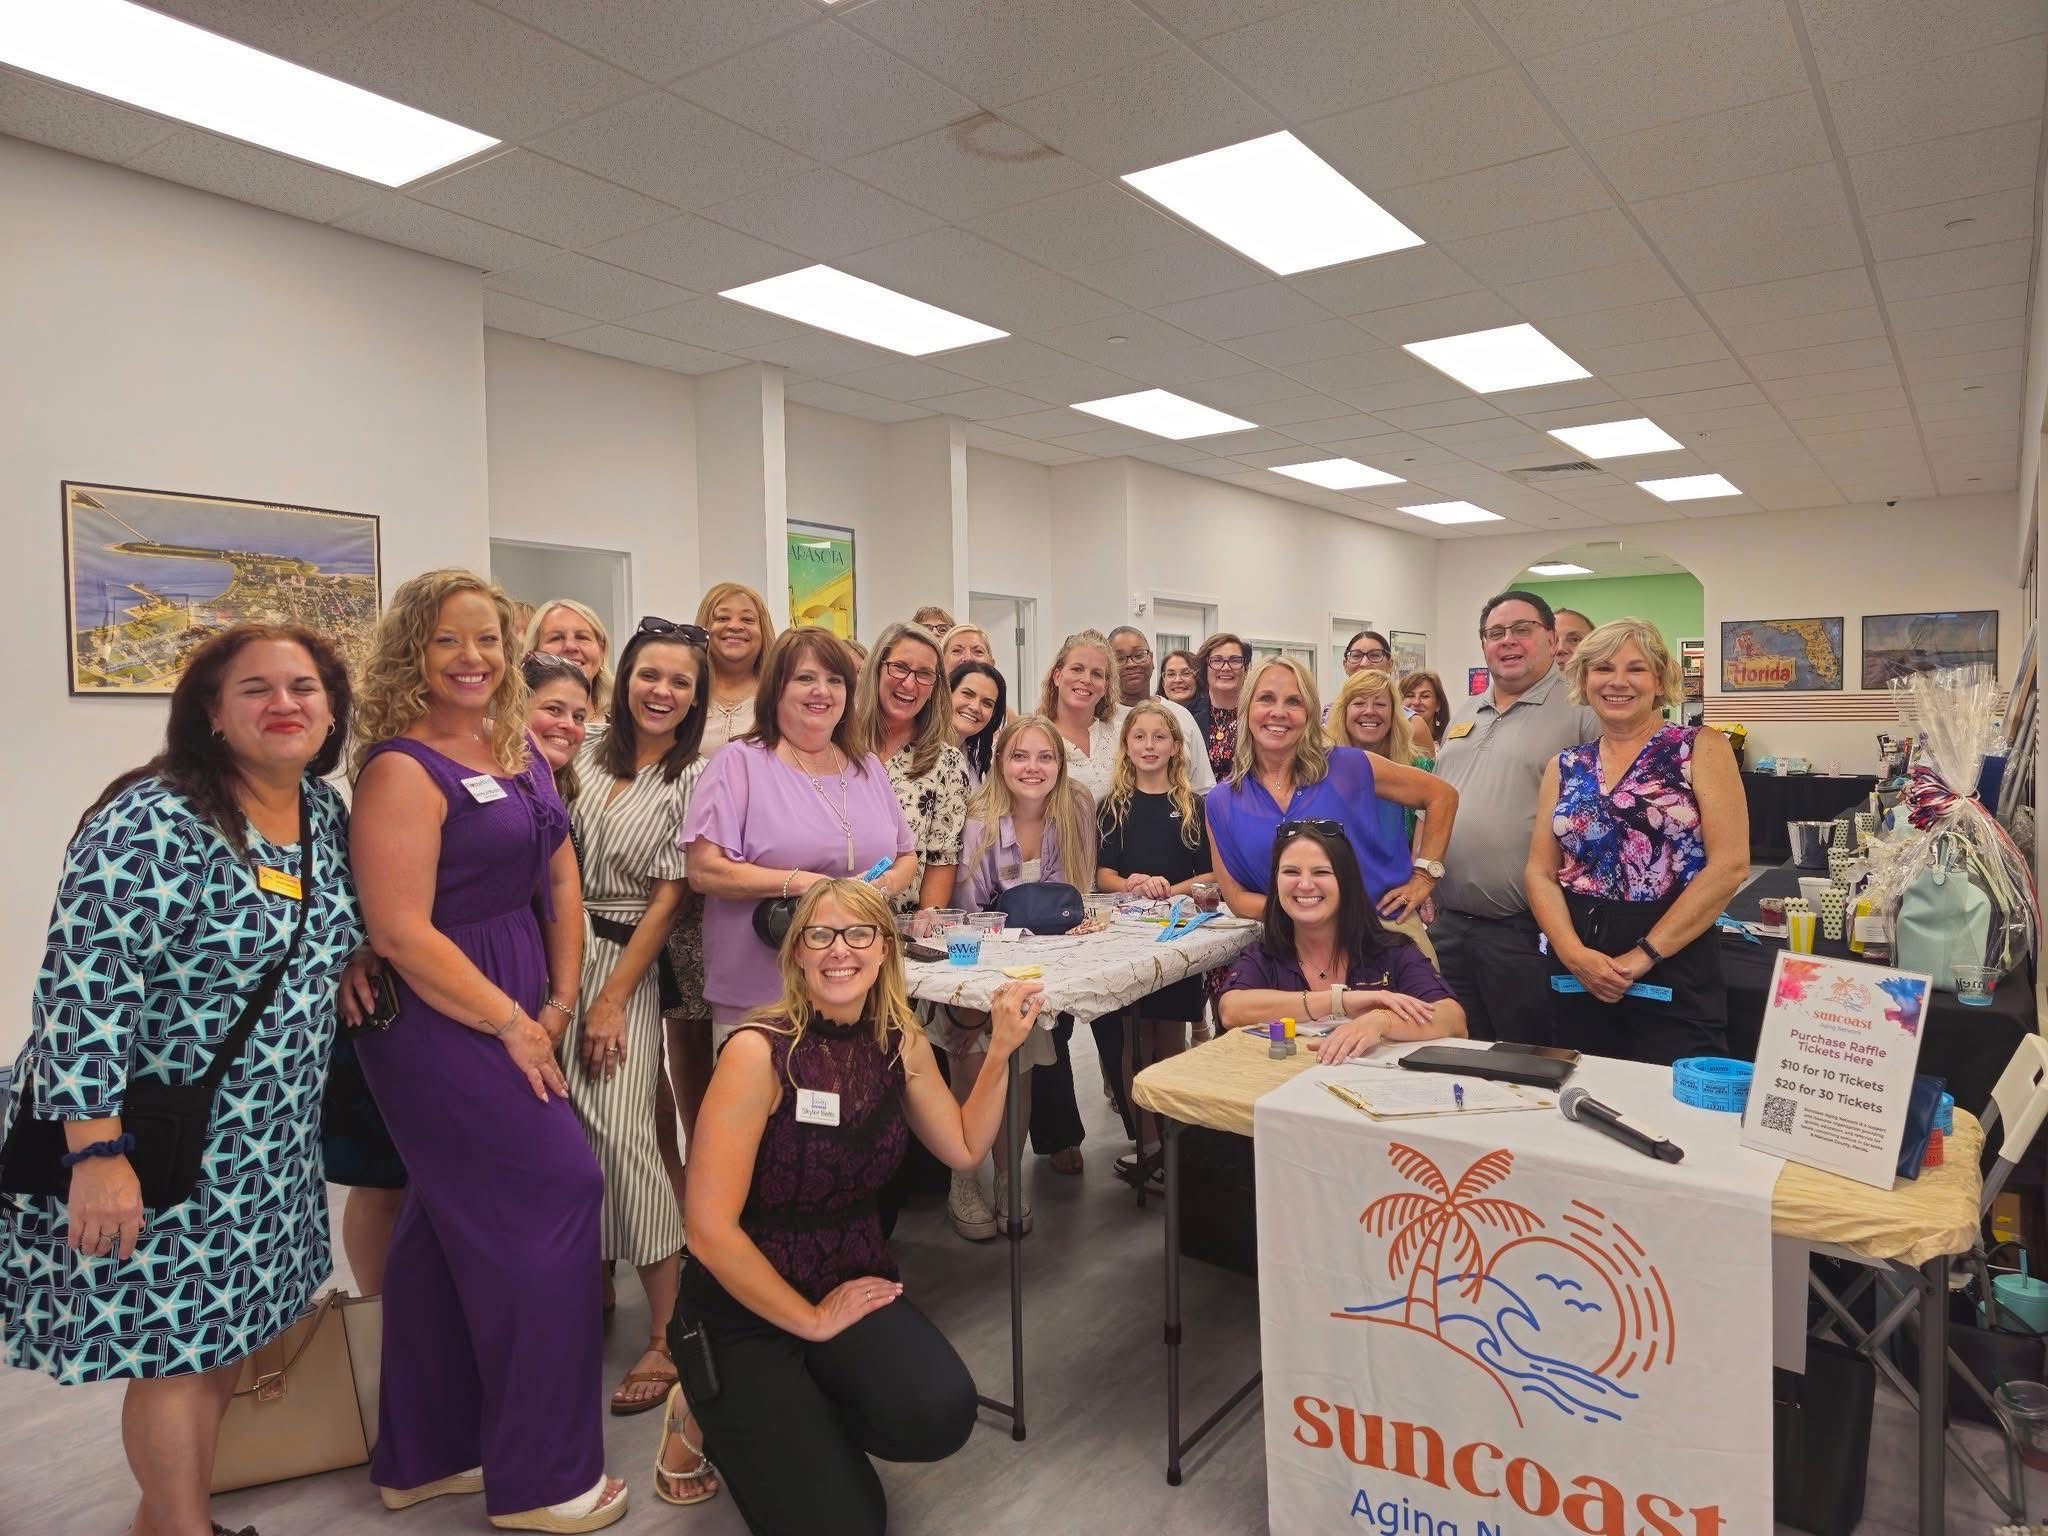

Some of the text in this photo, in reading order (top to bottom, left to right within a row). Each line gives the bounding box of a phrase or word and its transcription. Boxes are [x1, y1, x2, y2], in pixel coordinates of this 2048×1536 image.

[1813, 1010, 1872, 1030] suncoast
[1790, 1029, 1846, 1049] Purchase
[1850, 1042, 1887, 1058] Raffle
[1798, 1041, 1874, 1067] Tickets Here
[1780, 1059, 1884, 1093] $10 for 10 Tickets
[1774, 1077, 1796, 1091] $20
[1799, 1084, 1816, 1096] for
[1818, 1089, 1834, 1101] 30
[1837, 1093, 1883, 1113] Tickets
